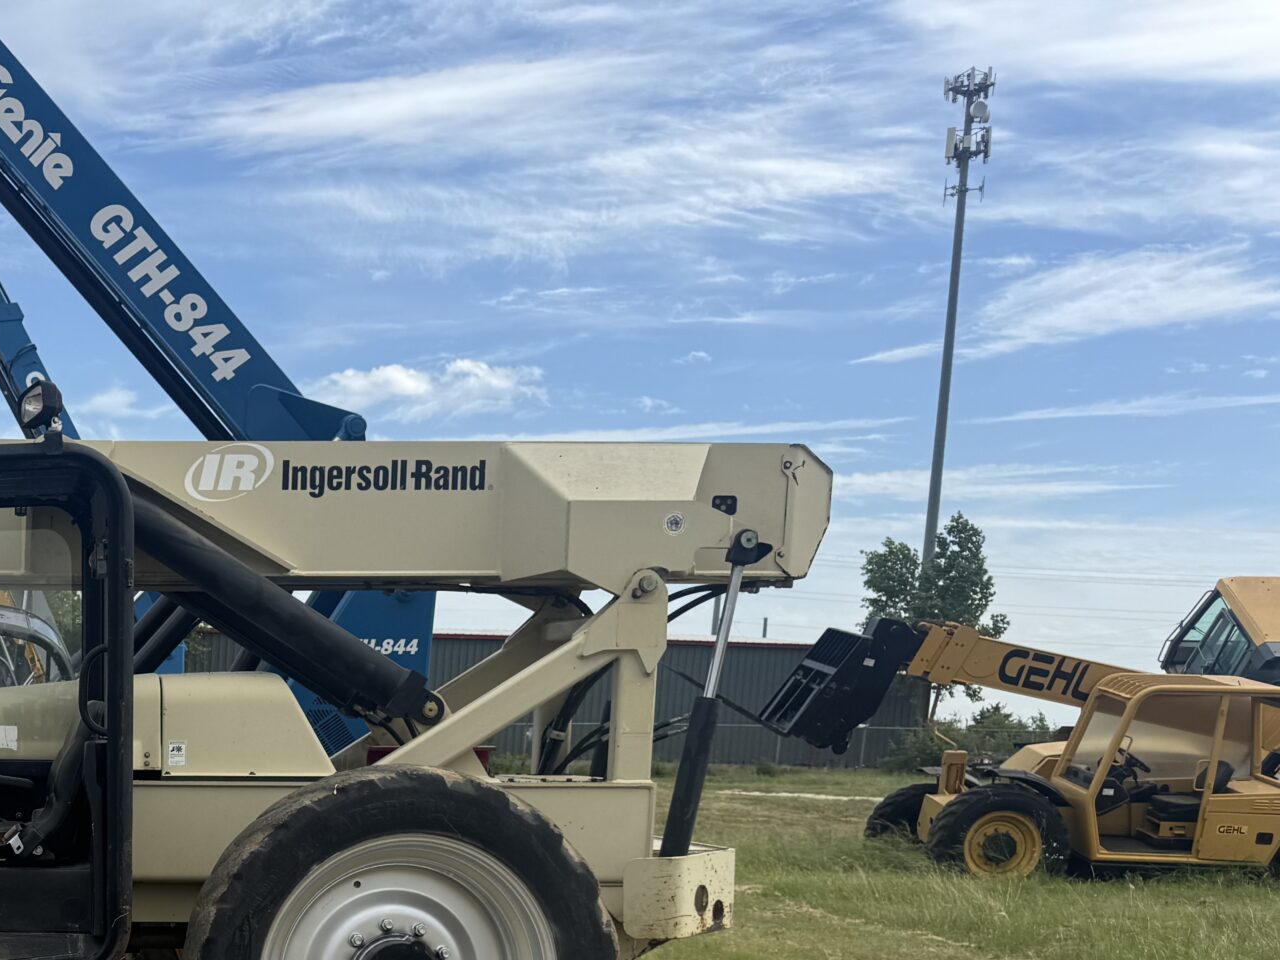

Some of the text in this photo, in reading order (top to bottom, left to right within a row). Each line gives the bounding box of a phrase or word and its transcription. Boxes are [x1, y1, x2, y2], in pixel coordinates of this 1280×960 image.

[89, 203, 252, 383] GTH-844
[198, 453, 259, 491] IR
[998, 648, 1090, 702] GEHL
[1217, 825, 1246, 835] GEHL
